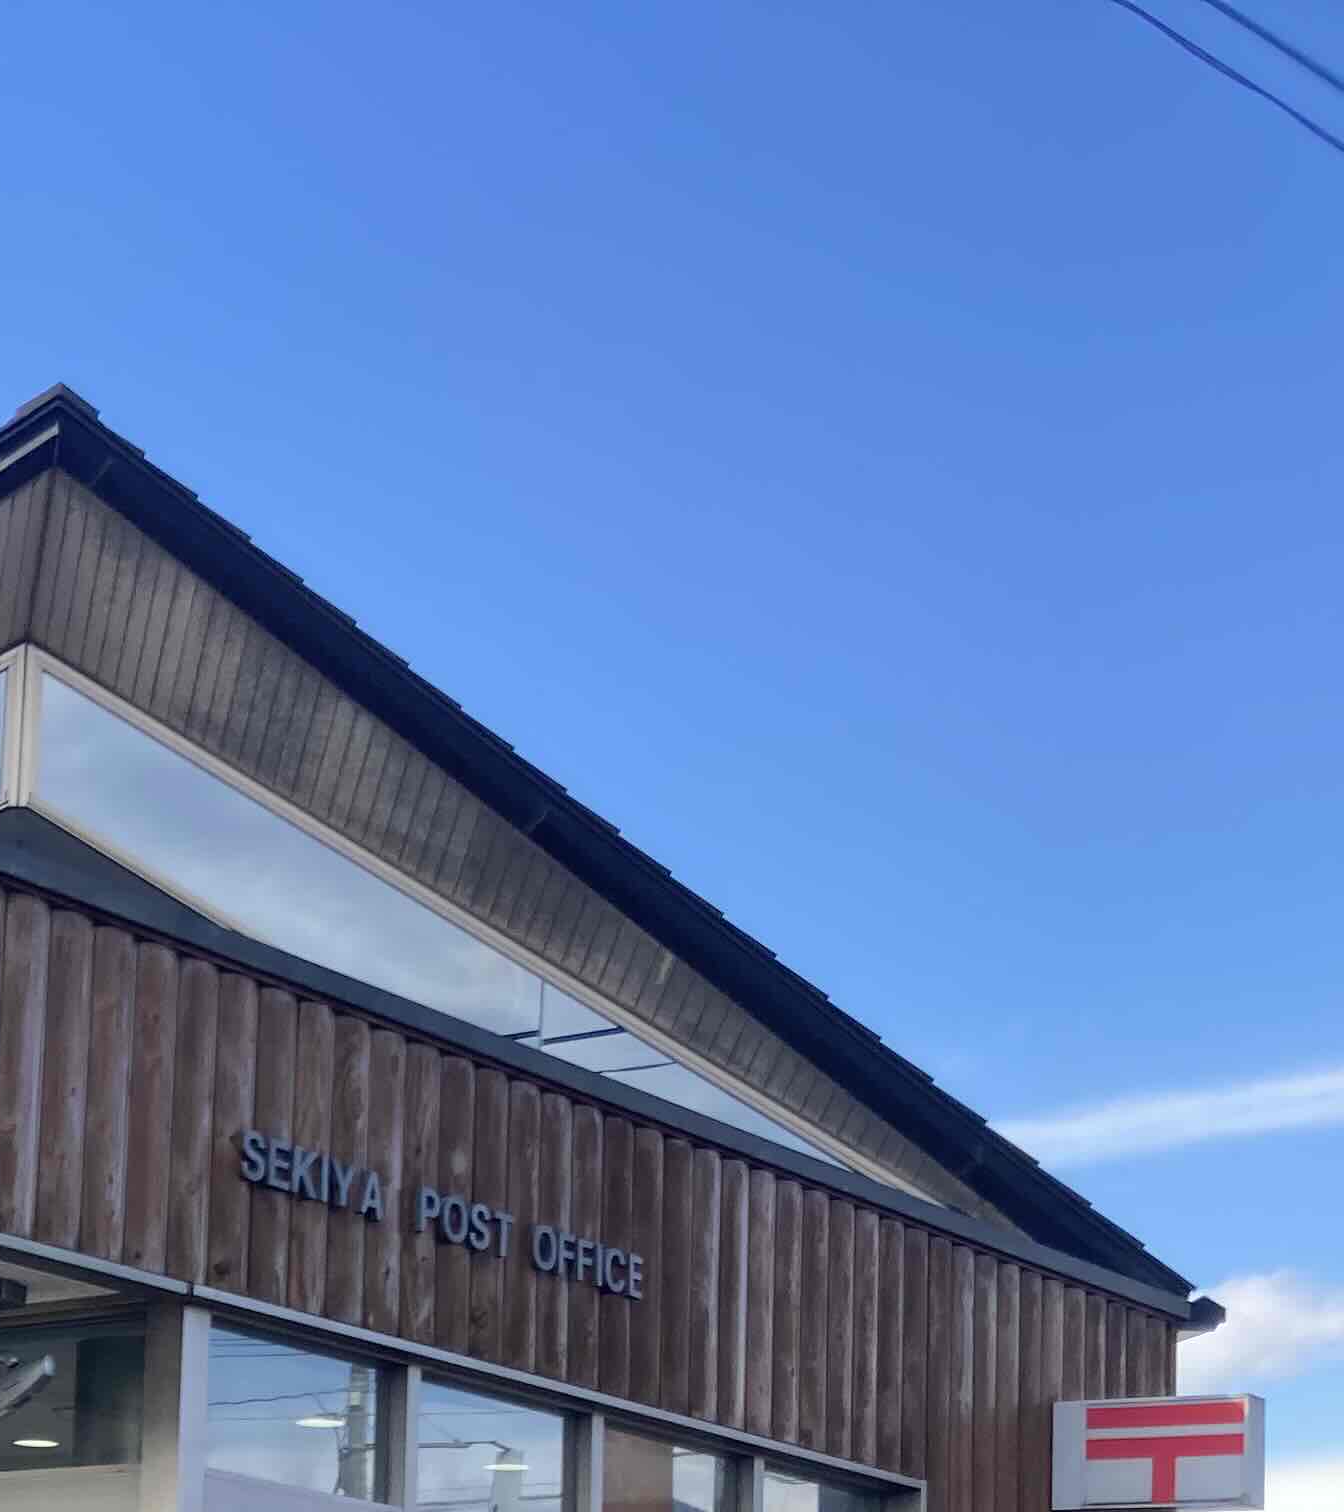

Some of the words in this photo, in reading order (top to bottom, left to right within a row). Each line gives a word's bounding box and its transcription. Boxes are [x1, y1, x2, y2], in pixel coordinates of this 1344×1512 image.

[241, 1130, 385, 1221] SEKIYA
[415, 1184, 513, 1257] POST
[530, 1224, 643, 1299] OFFICE
